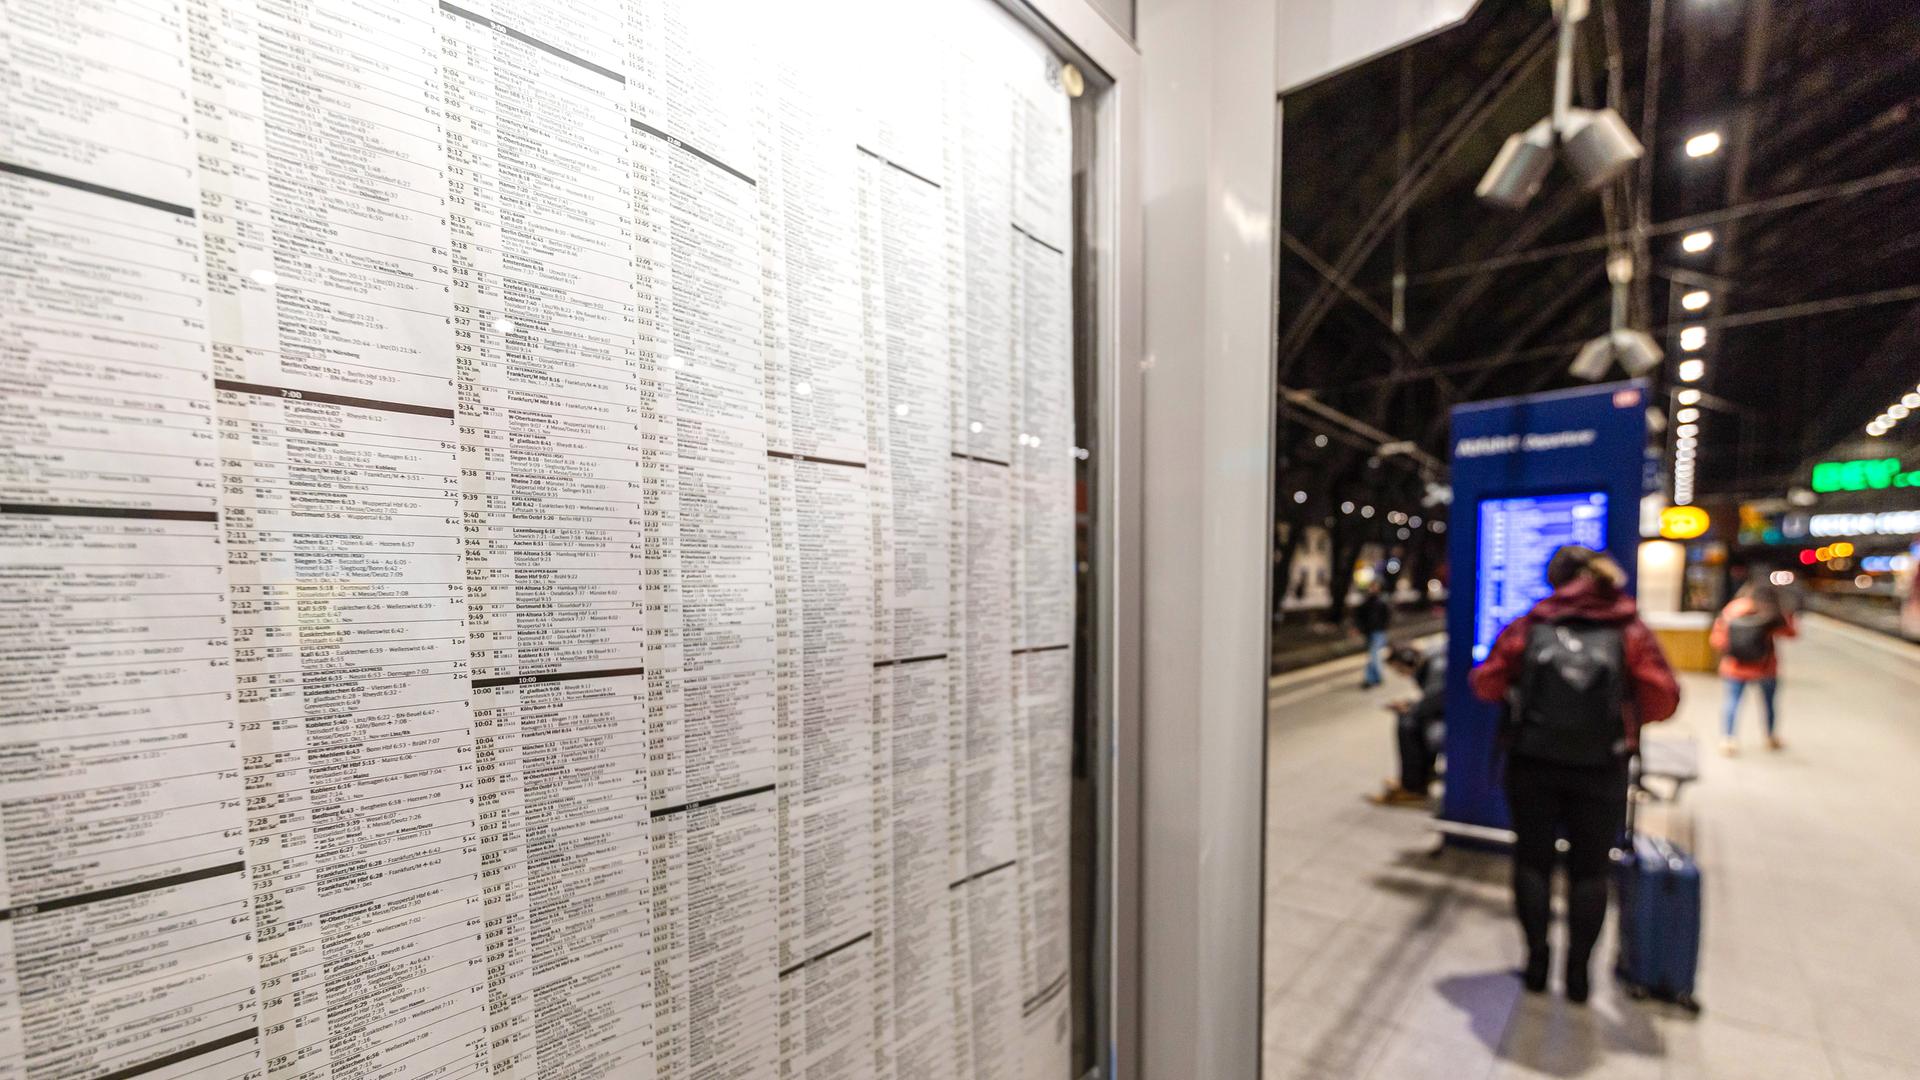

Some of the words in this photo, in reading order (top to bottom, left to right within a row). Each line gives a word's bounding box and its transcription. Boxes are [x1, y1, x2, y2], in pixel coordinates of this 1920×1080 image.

[447, 131, 462, 141] 9:10
[447, 147, 463, 157] 9:12
[448, 166, 464, 175] 9:12
[449, 180, 464, 189] 9:12
[449, 195, 465, 205] 9:12
[450, 215, 466, 224] 9:15
[451, 241, 467, 250] 9:18
[453, 267, 469, 276] 9:18
[453, 280, 469, 289] 9:22
[454, 305, 470, 313] 9:22
[455, 318, 470, 326] 9:27
[455, 330, 471, 339] 9:28
[456, 344, 472, 352] 9:29
[457, 358, 472, 366] 9:33
[458, 384, 473, 392] 9:33
[241, 723, 260, 731] 7:22
[245, 776, 264, 784] 7:27
[247, 797, 266, 805] 7:28
[480, 812, 497, 820] 10:12
[250, 838, 270, 846] 7:29
[481, 836, 499, 844] 10:12
[482, 852, 499, 860] 10:13
[252, 865, 271, 874] 7:31
[482, 869, 500, 877] 10:15
[253, 880, 273, 889] 7:33
[483, 886, 501, 894] 10:18
[255, 894, 274, 903] 7:33
[484, 897, 501, 905] 10:22
[485, 919, 503, 927] 10:22
[257, 928, 277, 937] 7:33
[486, 930, 503, 939] 10:28
[487, 943, 504, 951] 10:28
[259, 955, 278, 963] 7:34
[487, 954, 504, 962] 10:29
[487, 966, 505, 974] 10:32
[262, 980, 281, 989] 7:35
[488, 979, 505, 987] 10:33
[263, 1000, 282, 1009] 7:36
[489, 1002, 507, 1010] 10:34
[265, 1026, 284, 1035] 7:38
[267, 1057, 287, 1067] 7:39
